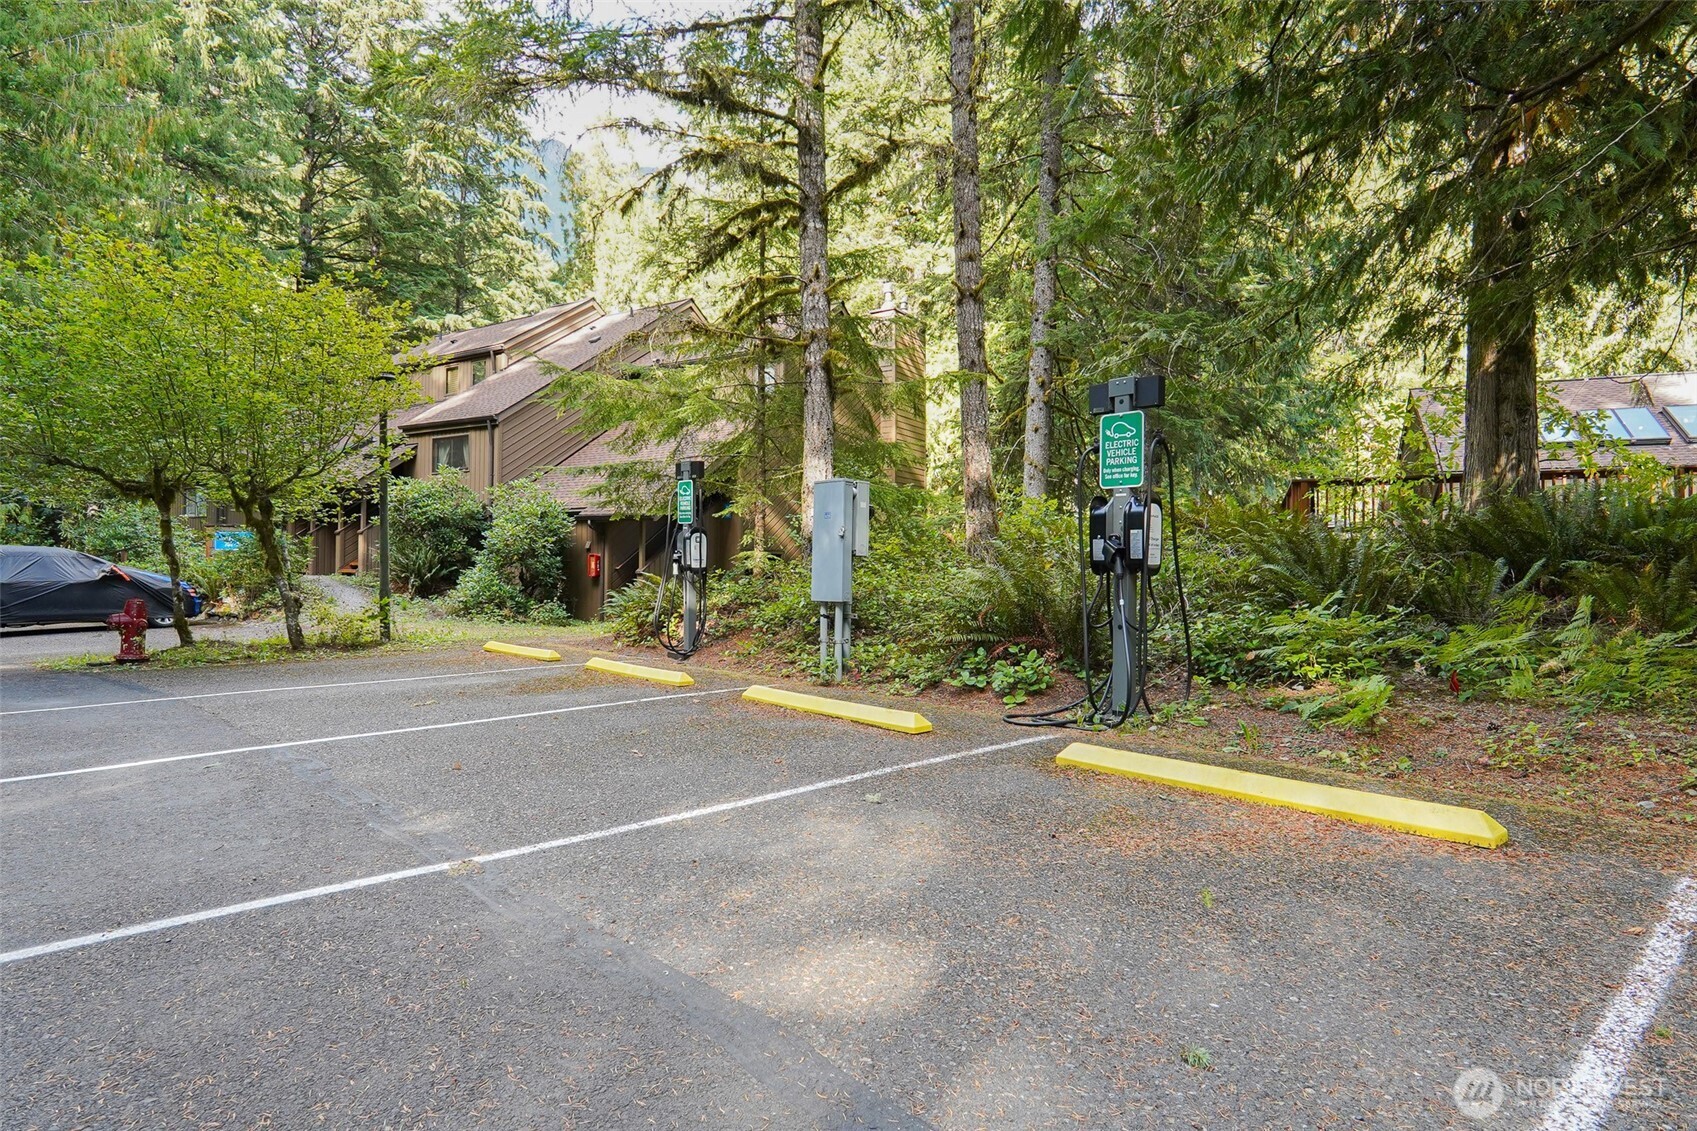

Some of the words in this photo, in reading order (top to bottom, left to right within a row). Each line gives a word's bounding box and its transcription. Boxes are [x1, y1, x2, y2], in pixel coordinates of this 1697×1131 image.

[1105, 438, 1139, 449] ELECTRIC
[1106, 447, 1137, 457] VEHICLE
[1106, 456, 1137, 466] PARKING
